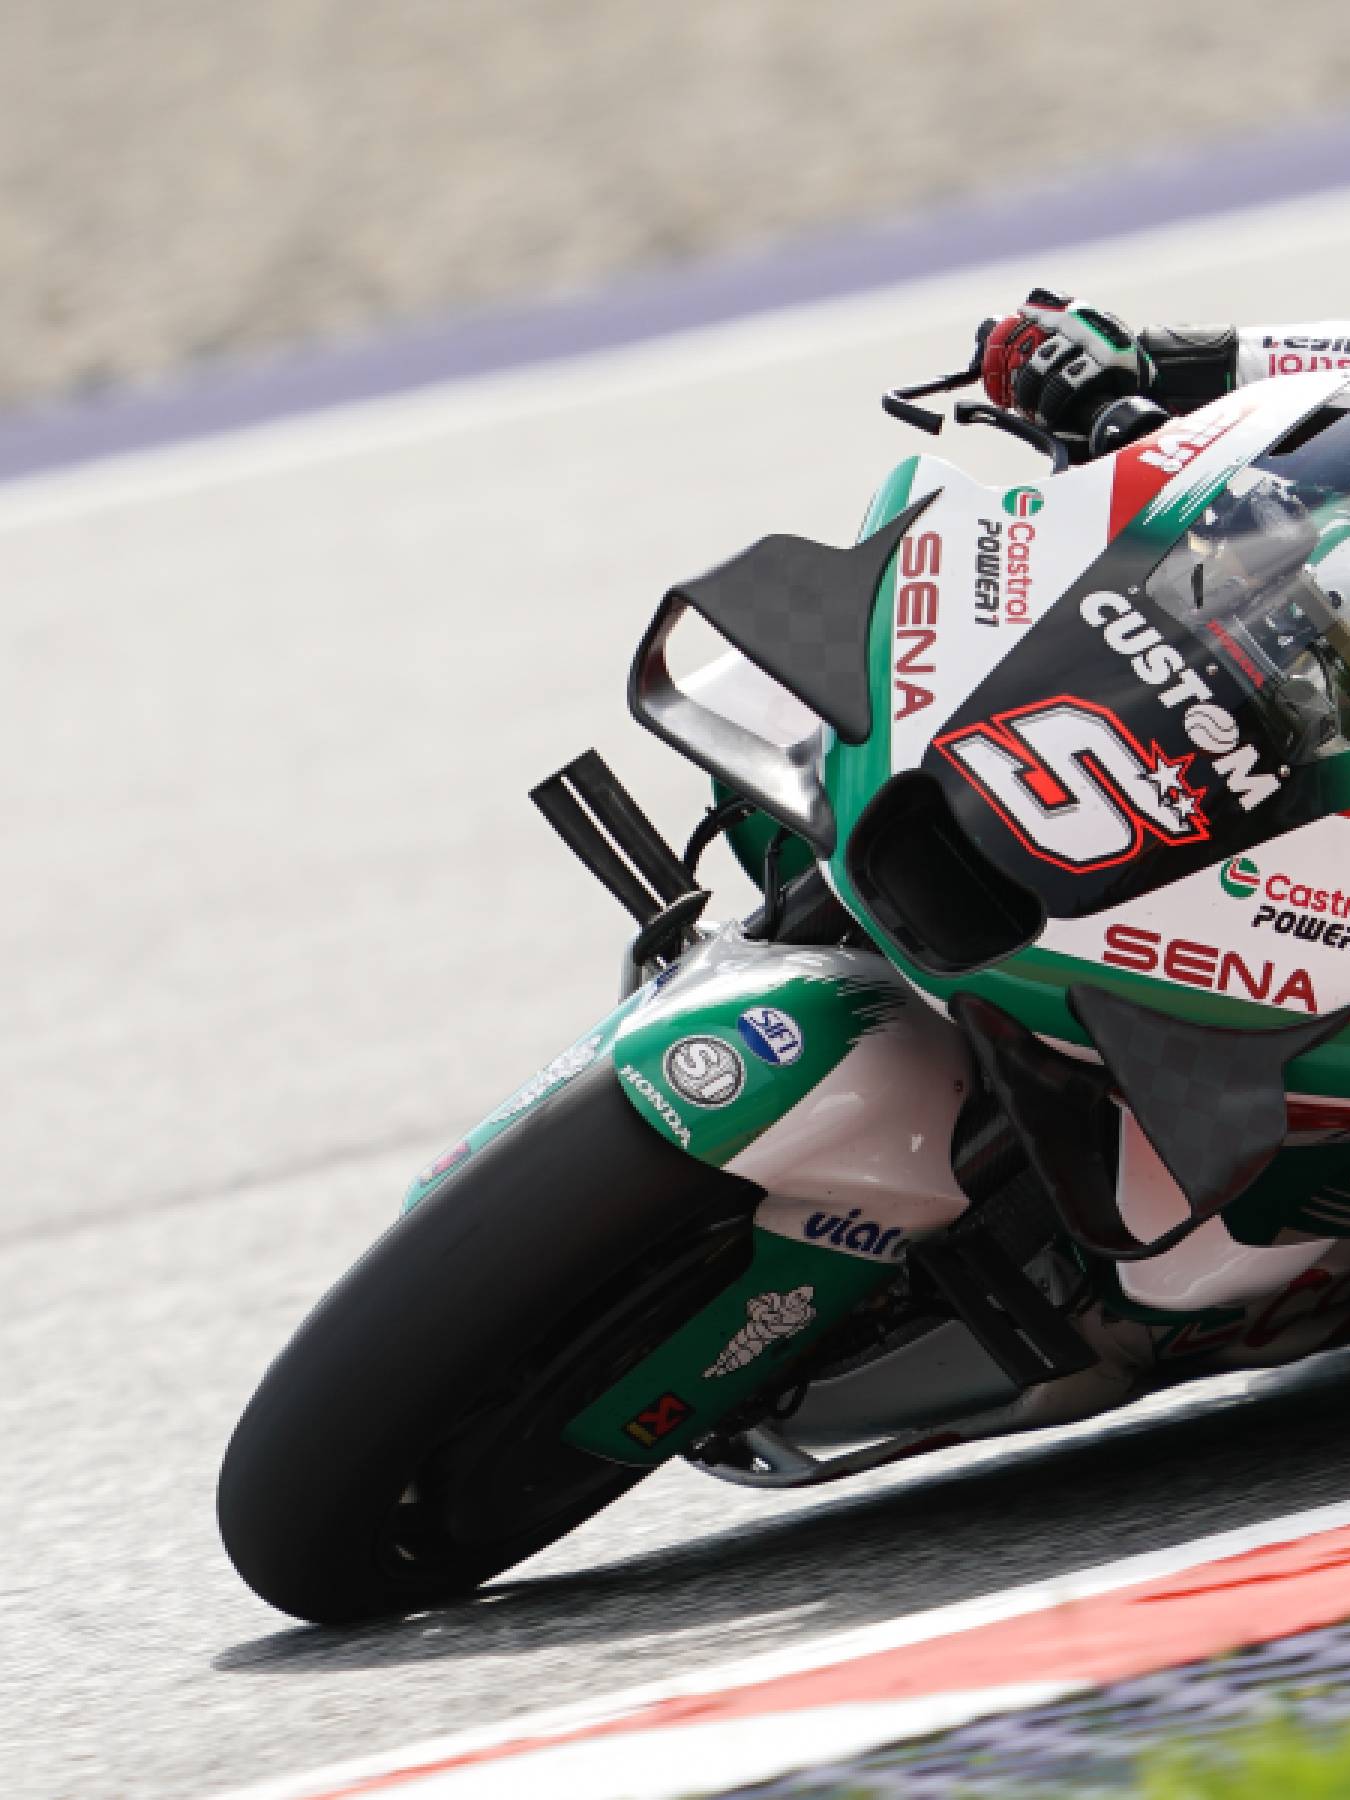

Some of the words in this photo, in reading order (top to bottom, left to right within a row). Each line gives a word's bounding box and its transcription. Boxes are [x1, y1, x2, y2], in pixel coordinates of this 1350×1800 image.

[894, 530, 943, 721] SENA
[975, 518, 1003, 628] POWER1
[1005, 522, 1036, 625] Castrol
[1079, 590, 1281, 811] CUSTOM
[935, 694, 1209, 873] 5
[1103, 923, 1318, 1017] SENA
[620, 1064, 691, 1149] HONDA
